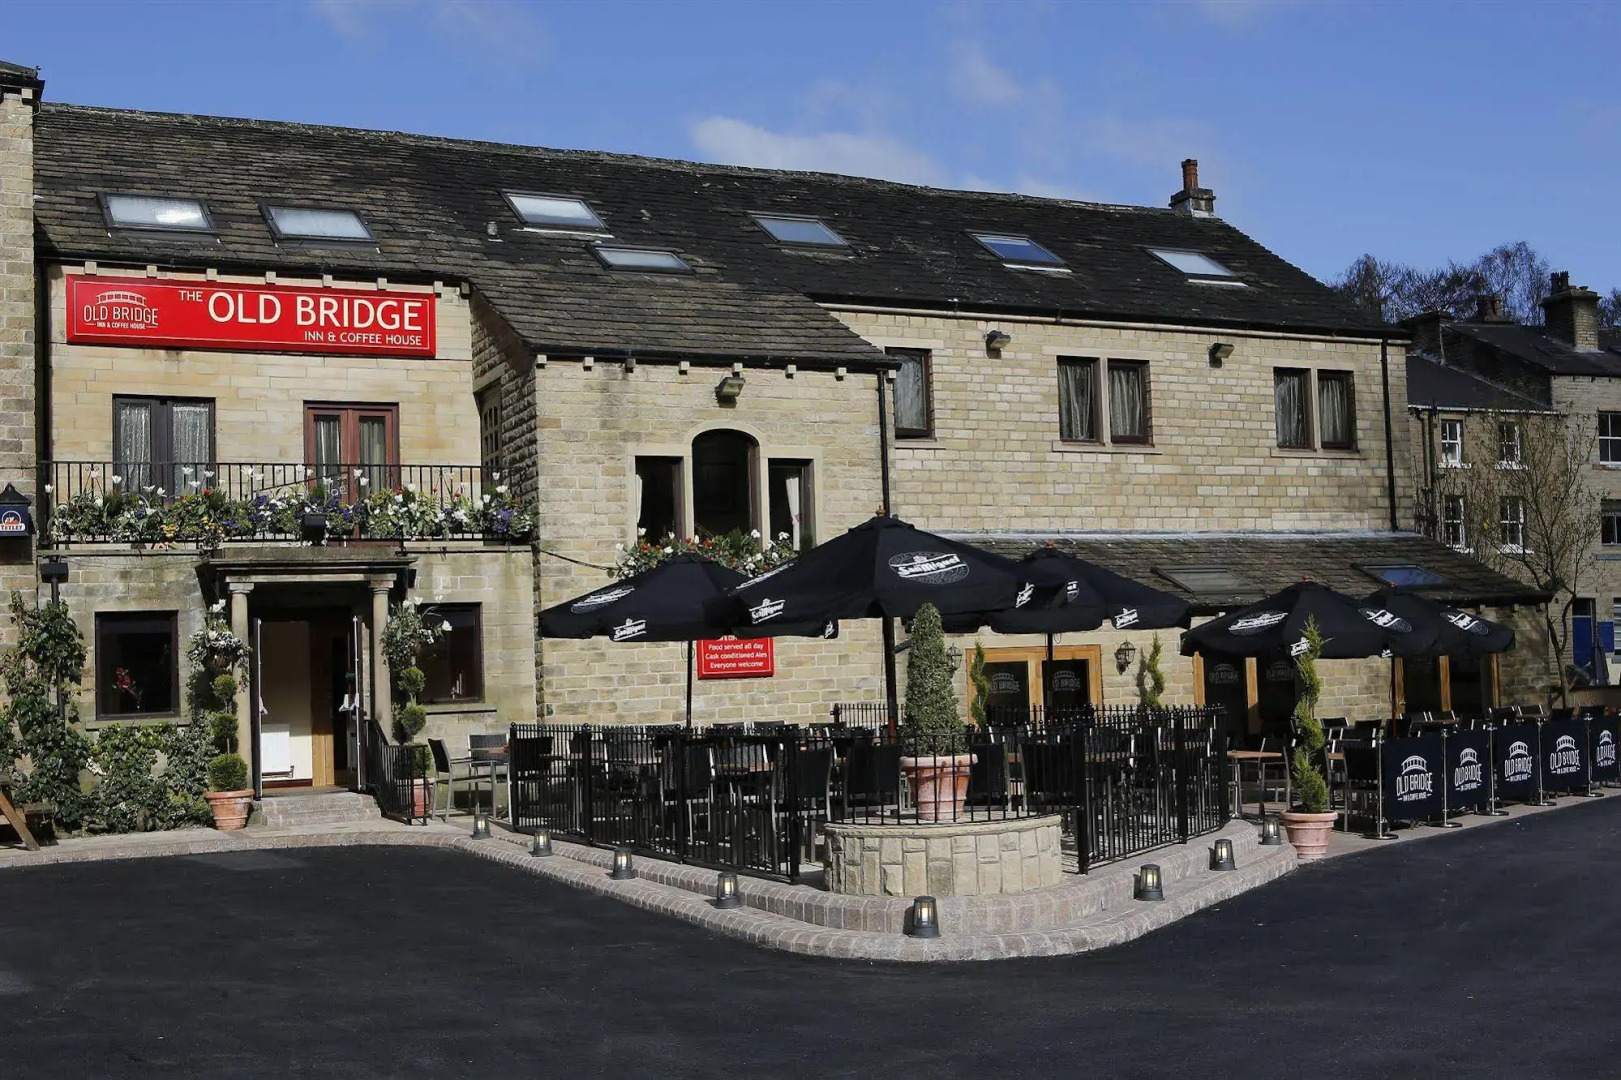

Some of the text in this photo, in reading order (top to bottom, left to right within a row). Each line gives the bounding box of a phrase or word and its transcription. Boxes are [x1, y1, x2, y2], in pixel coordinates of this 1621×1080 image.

[83, 305, 159, 326] OLD BRIDGE
[178, 290, 422, 331] THE OLD BRIDGE
[304, 331, 422, 346] INN & COFFEE HOUSE
[1504, 758, 1514, 778] OLD
[1515, 756, 1533, 774] BRIDGE
[1549, 752, 1561, 770] OLD
[1562, 750, 1580, 766] BRIDGE
[1396, 772, 1433, 797] OLD BRIDGE
[1454, 765, 1465, 787] OLD
[1465, 763, 1482, 782] BRIDGE
